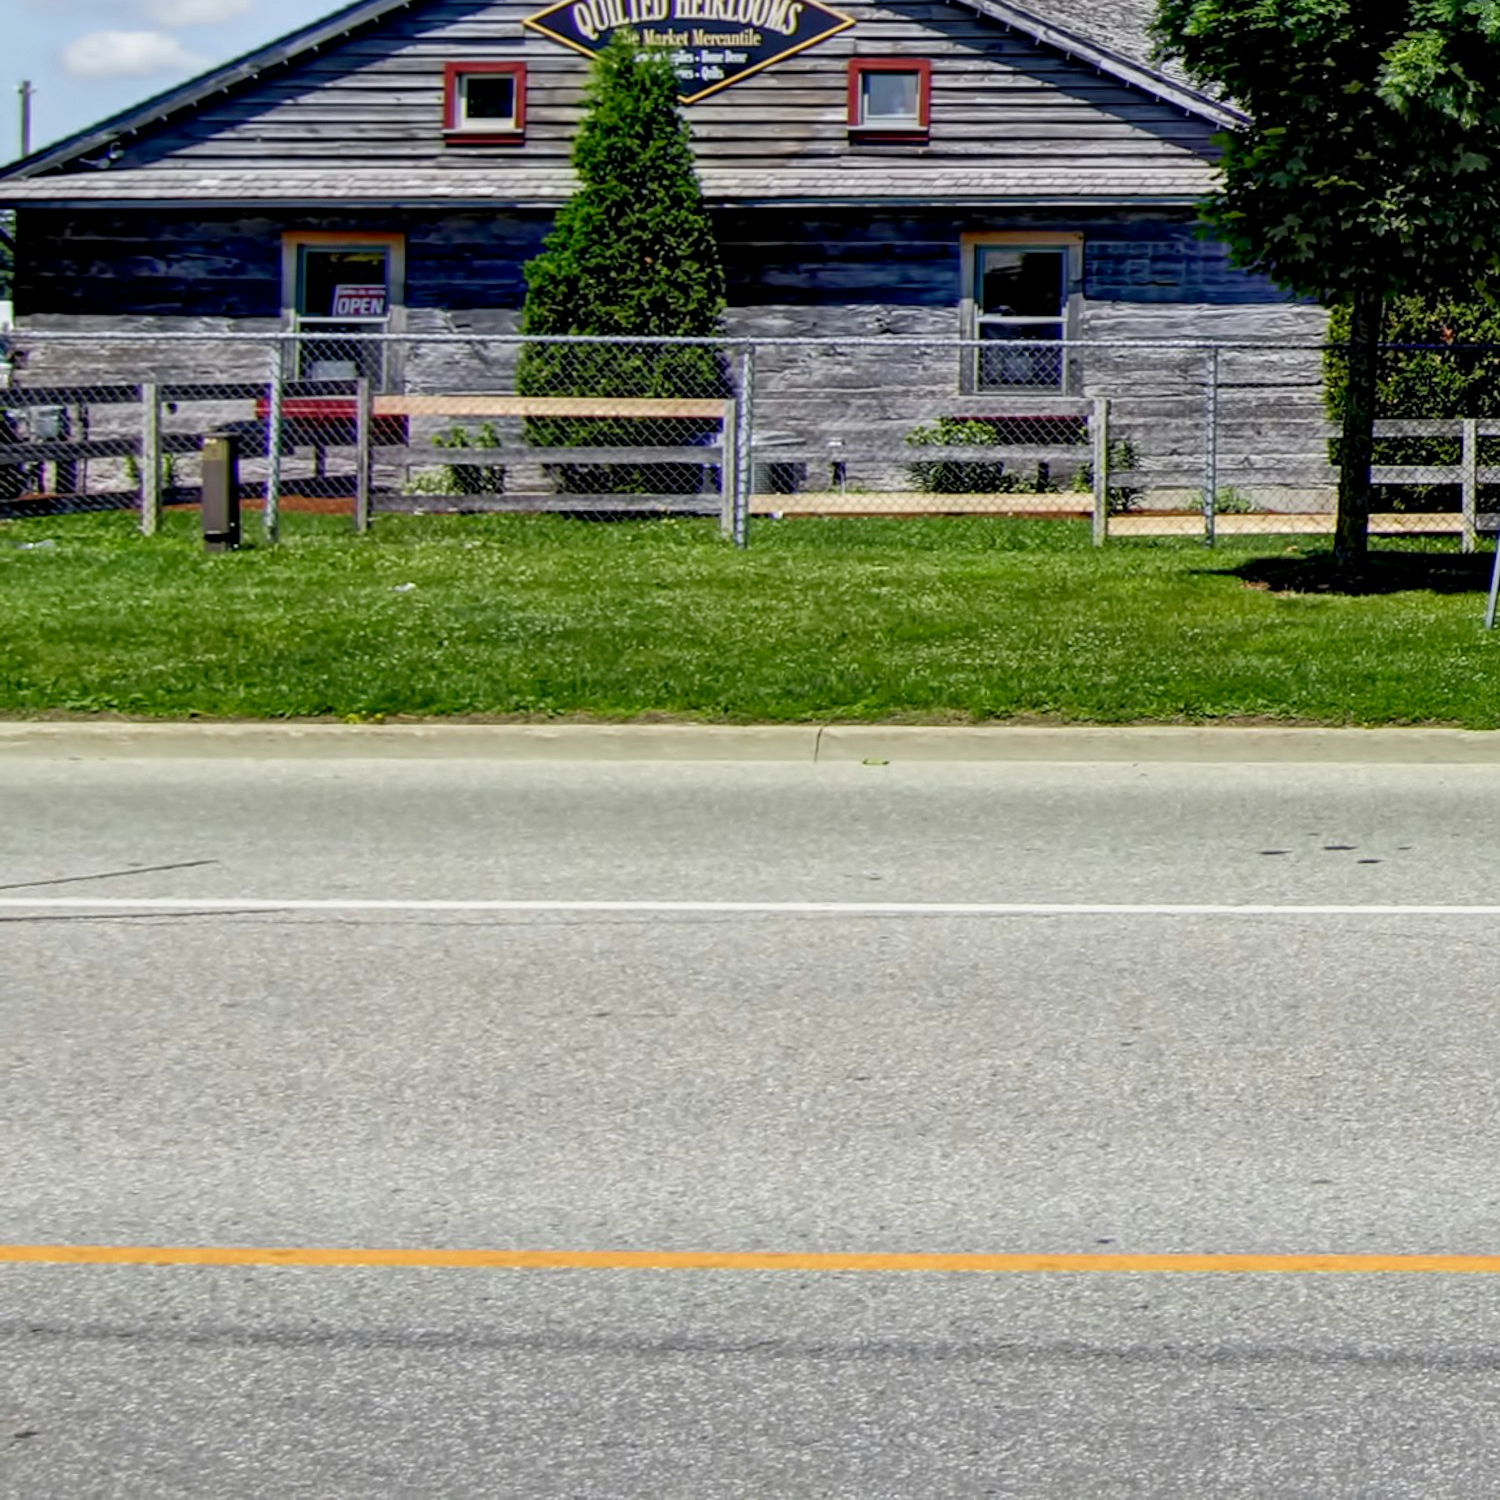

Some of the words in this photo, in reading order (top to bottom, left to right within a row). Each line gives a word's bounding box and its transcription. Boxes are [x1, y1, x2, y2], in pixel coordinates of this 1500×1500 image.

[643, 28, 689, 46] Market
[692, 28, 762, 46] Mercantile
[337, 298, 384, 315] OPEN
